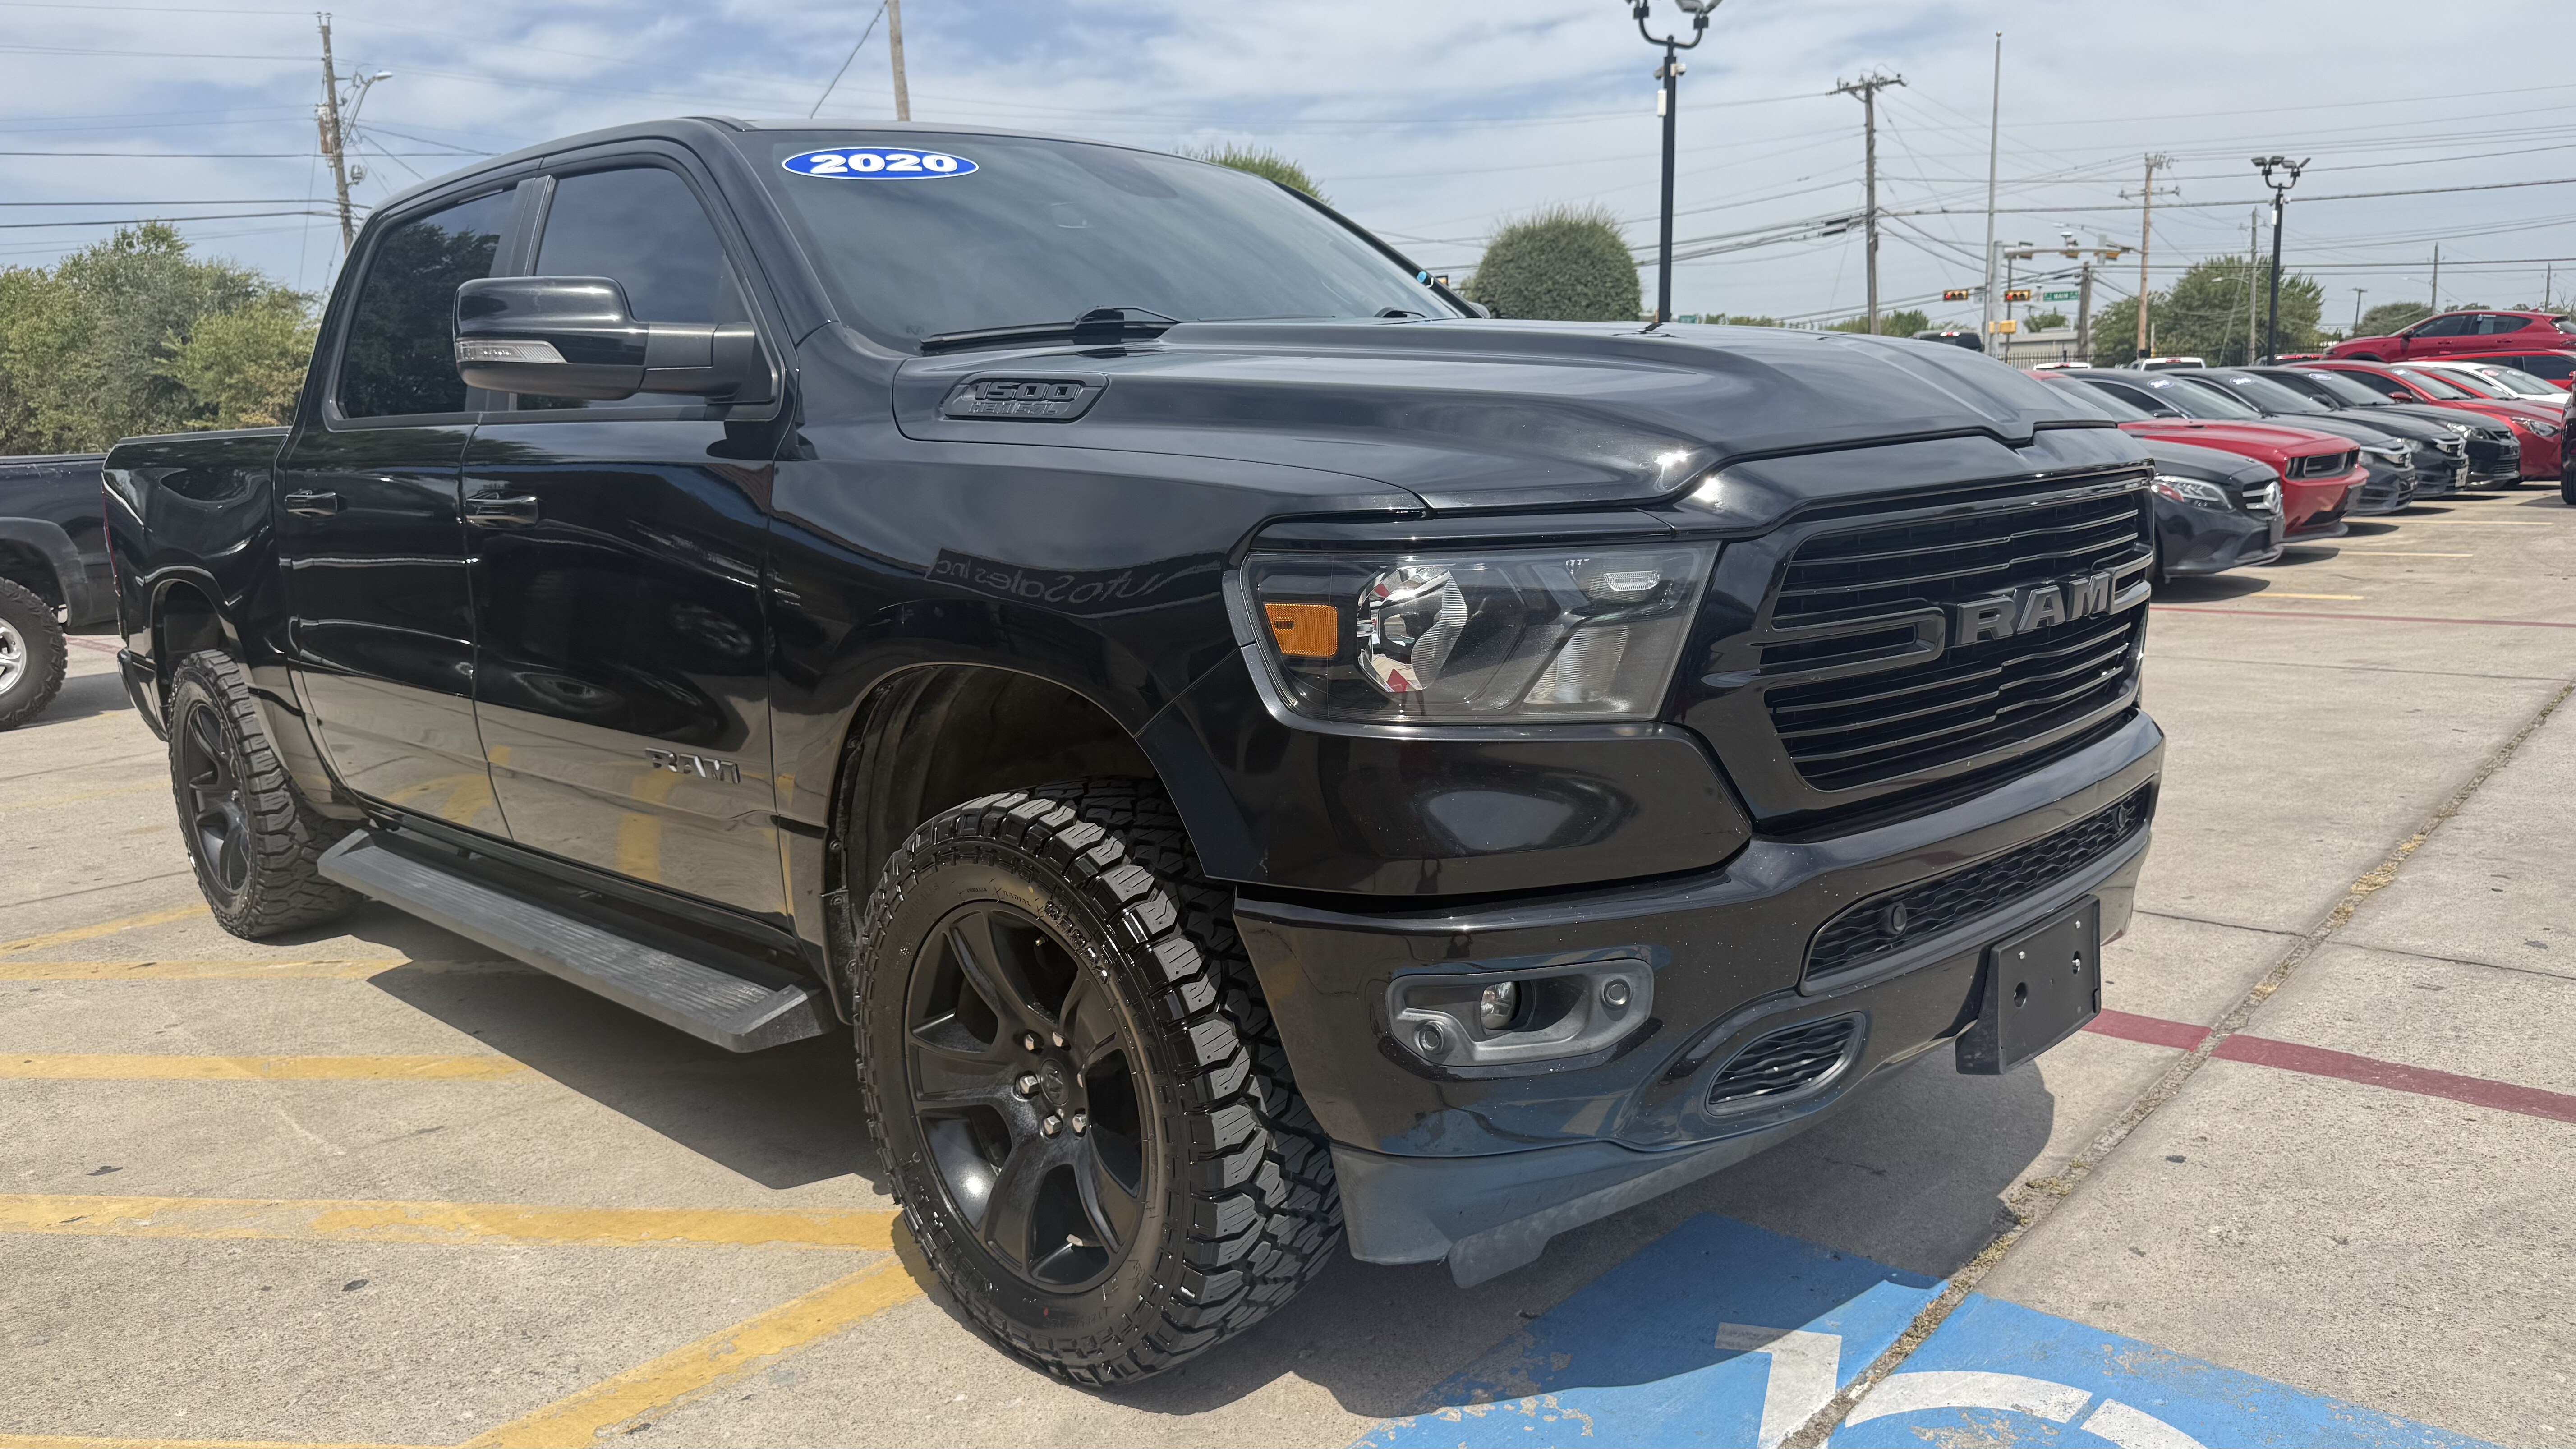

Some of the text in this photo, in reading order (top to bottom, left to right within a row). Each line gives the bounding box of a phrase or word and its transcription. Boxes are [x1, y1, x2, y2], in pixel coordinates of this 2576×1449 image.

[810, 153, 957, 174] 2020
[974, 382, 1081, 401] 1500
[1954, 572, 2110, 647] RAM
[645, 747, 741, 784] RAM
[1002, 890, 1031, 907] RADIAL
